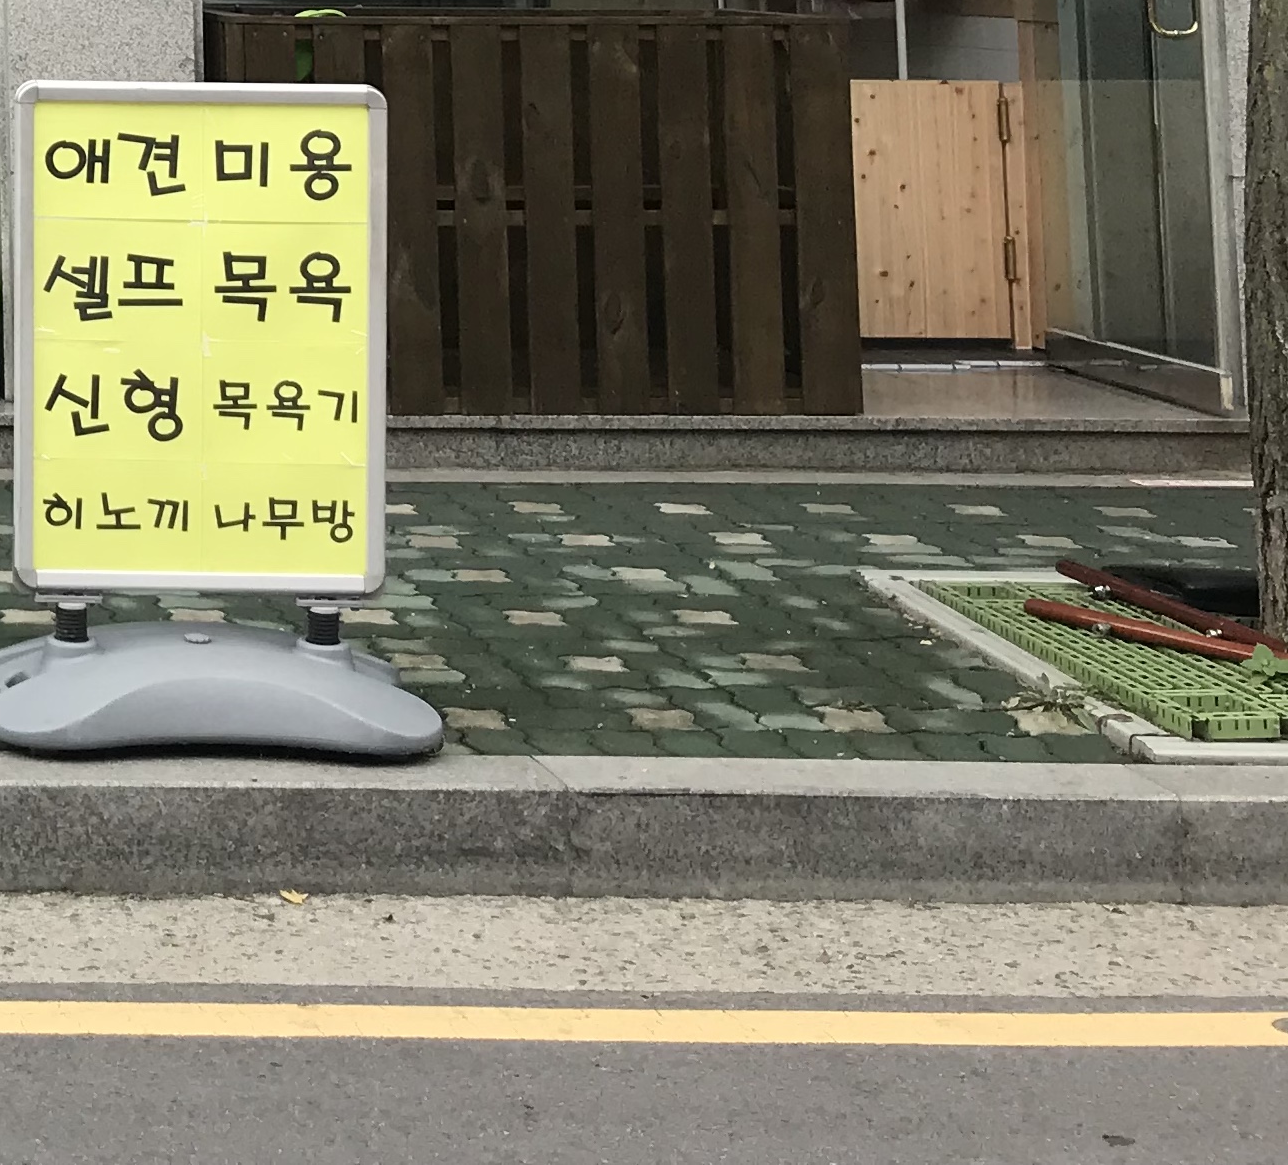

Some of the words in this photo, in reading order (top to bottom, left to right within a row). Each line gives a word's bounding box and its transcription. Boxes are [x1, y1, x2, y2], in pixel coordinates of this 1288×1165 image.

[45, 132, 186, 197] 애견
[214, 129, 353, 201] 미용
[43, 253, 183, 322] 셀프
[213, 251, 352, 323] 목욕
[44, 369, 184, 442] 신형
[213, 379, 359, 432] 목욕기
[42, 492, 189, 532] 히노끼
[214, 497, 355, 544] 나무방
